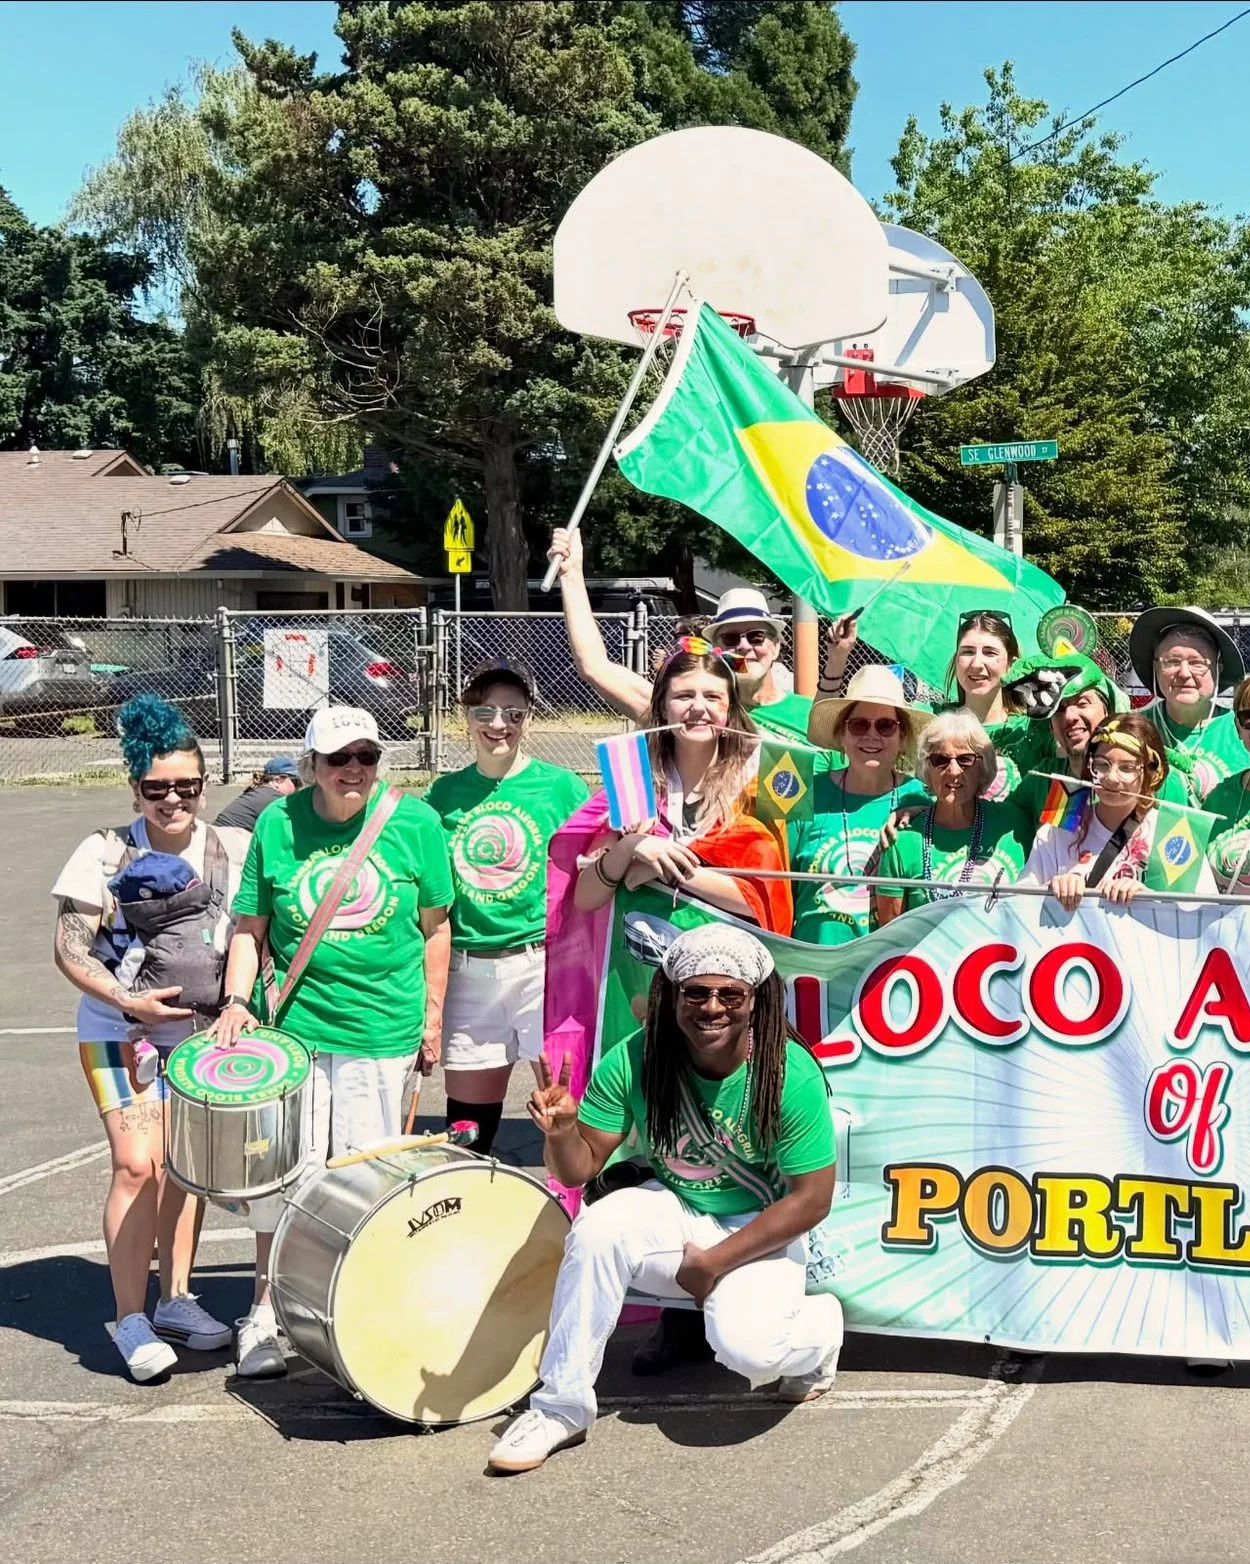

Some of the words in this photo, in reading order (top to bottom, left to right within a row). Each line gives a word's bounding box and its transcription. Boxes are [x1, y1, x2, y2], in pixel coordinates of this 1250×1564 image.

[968, 448, 979, 461] SE
[987, 444, 1037, 460] GLENWOOD
[473, 801, 513, 815] BLOCO
[512, 805, 543, 848] ALEGRIA
[496, 861, 540, 901] OREGON
[354, 895, 400, 940] OREGON
[792, 942, 1124, 1059] LOCO
[195, 1087, 243, 1103] BLOCO
[1147, 1061, 1229, 1171] Of
